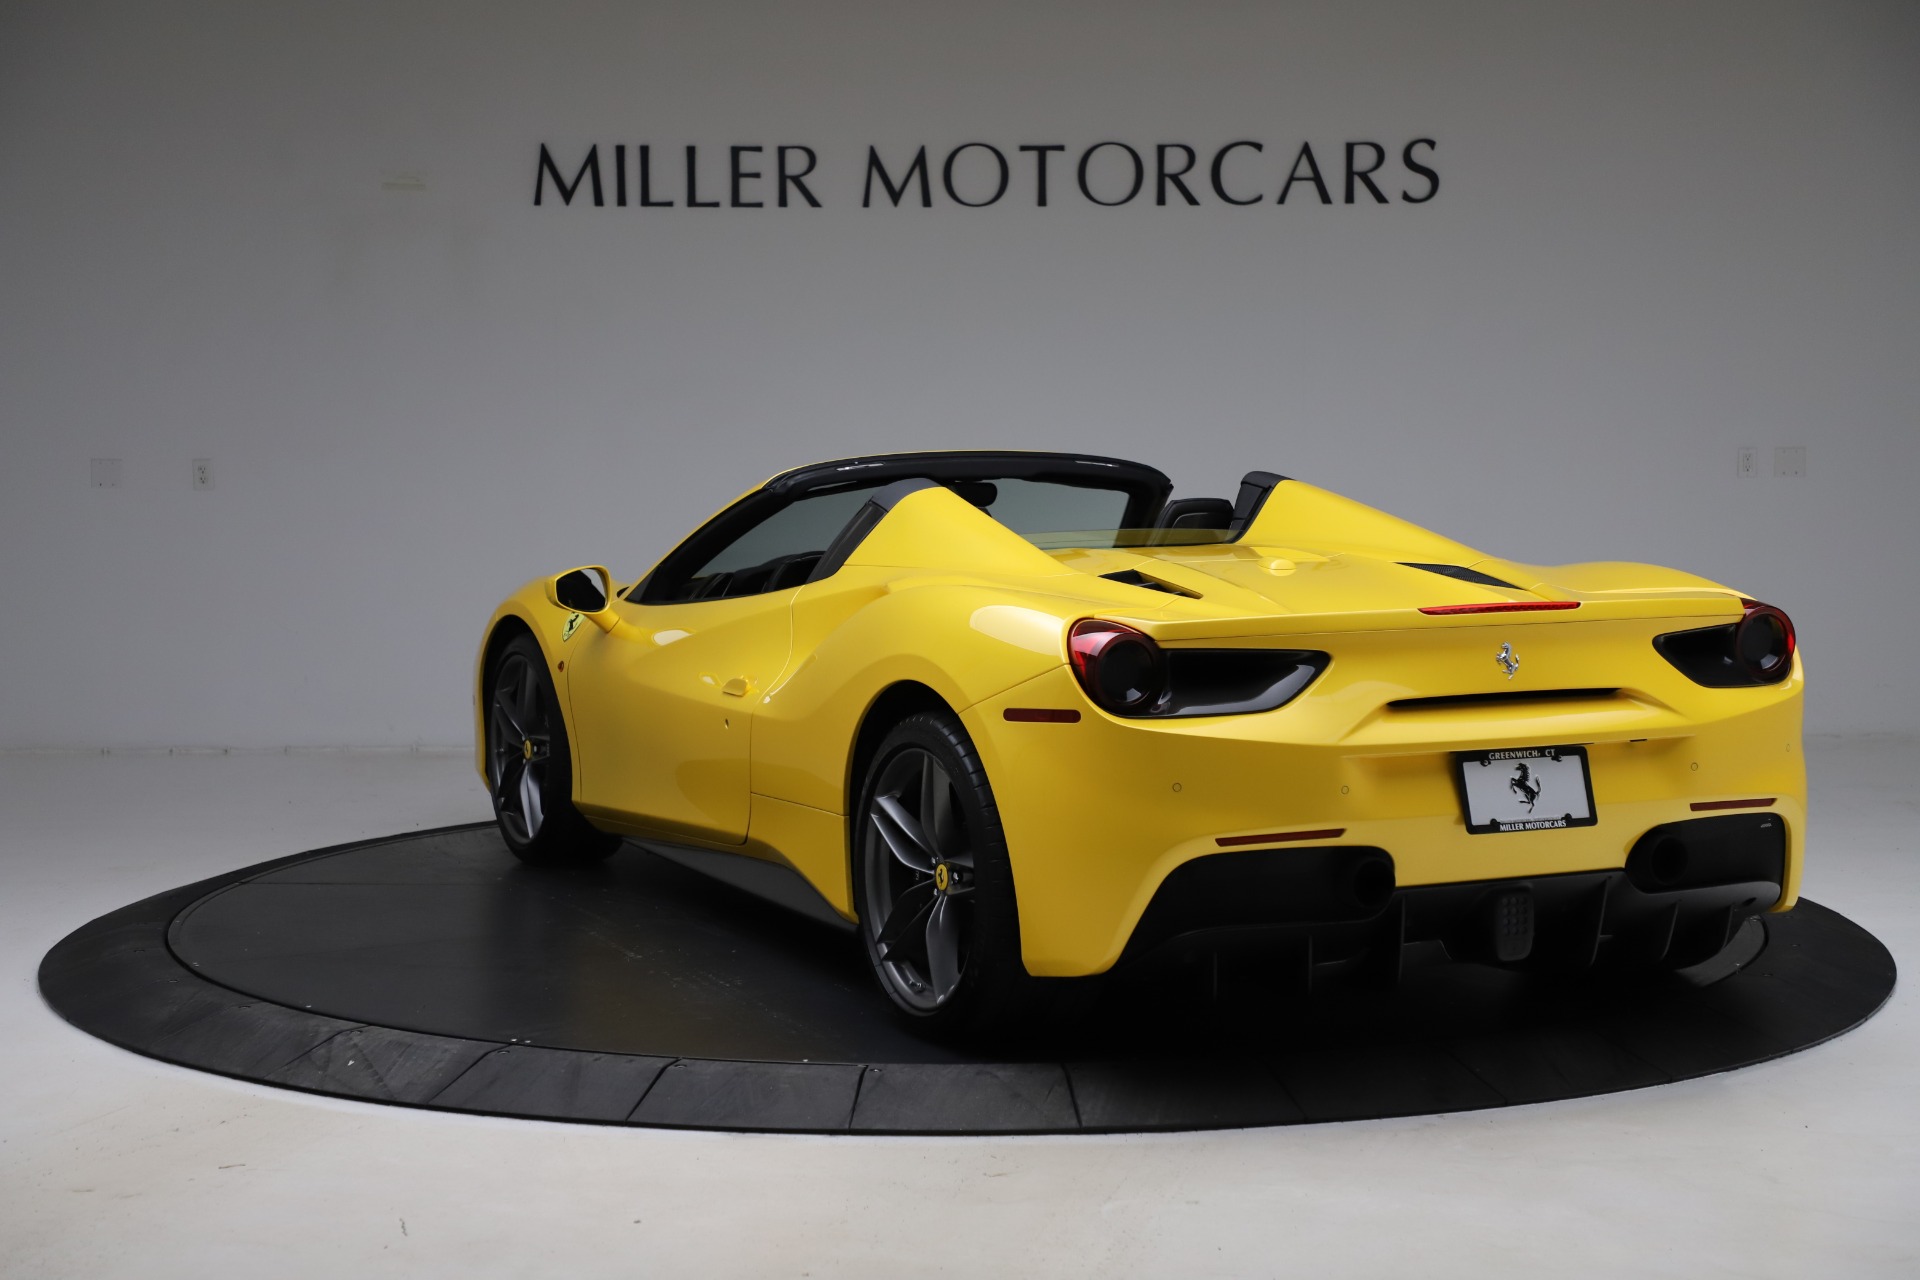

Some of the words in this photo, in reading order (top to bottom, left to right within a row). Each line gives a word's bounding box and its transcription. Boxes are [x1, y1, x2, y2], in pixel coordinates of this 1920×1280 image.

[532, 141, 822, 209] MILLER
[861, 137, 1440, 208] MOTORCARS
[1545, 748, 1556, 757] CT
[1500, 822, 1525, 832] MILLER
[1525, 820, 1567, 830] MOTORCARS
